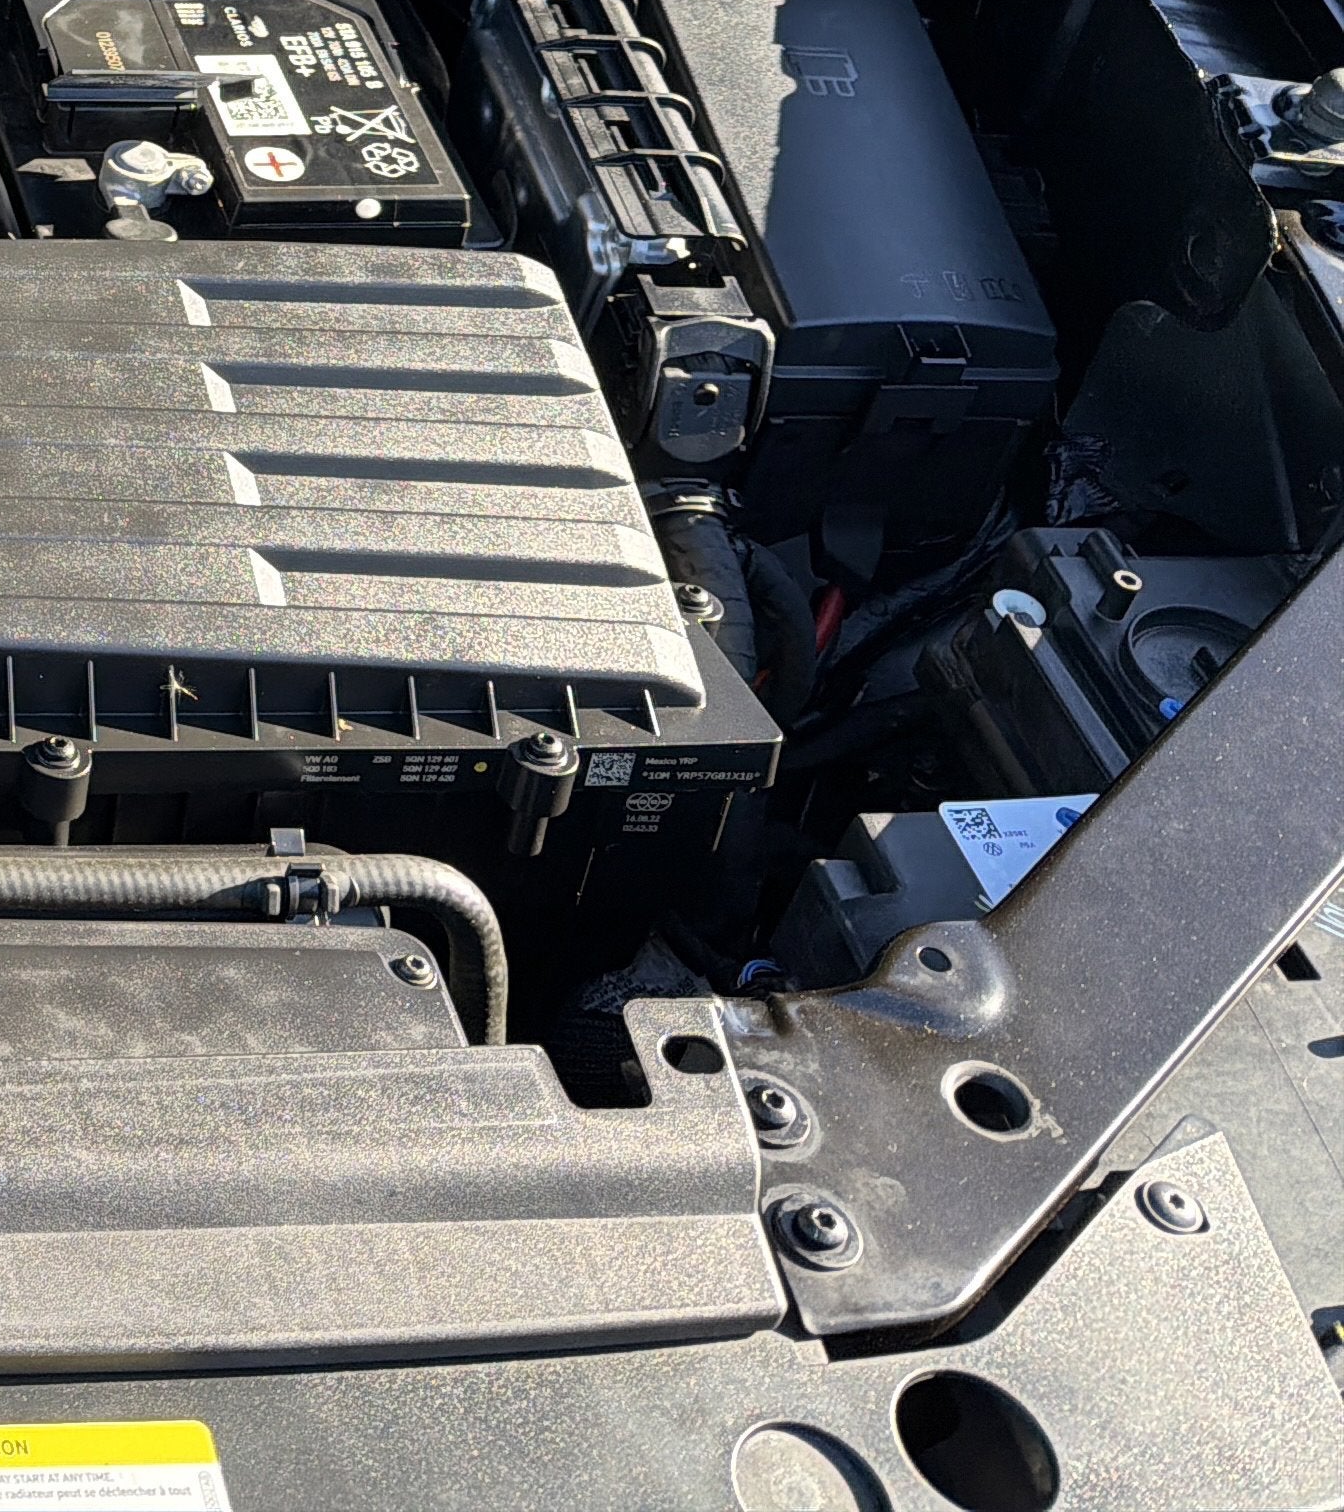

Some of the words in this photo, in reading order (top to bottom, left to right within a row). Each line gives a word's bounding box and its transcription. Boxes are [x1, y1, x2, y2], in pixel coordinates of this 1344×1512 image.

[224, 6, 254, 47] CLARIOS
[280, 36, 317, 77] EFB+
[310, 116, 332, 134] Pb
[645, 757, 677, 766] Mexico
[679, 757, 699, 765] YRP
[13, 1473, 46, 1483] START
[48, 1472, 61, 1482] AT
[62, 1472, 84, 1482] ANY
[5, 1488, 54, 1500] radiateur
[58, 1489, 81, 1501] peut
[83, 1489, 96, 1498] se
[98, 1485, 156, 1498] déclencher
[159, 1486, 166, 1497] à
[168, 1485, 192, 1496] tout
